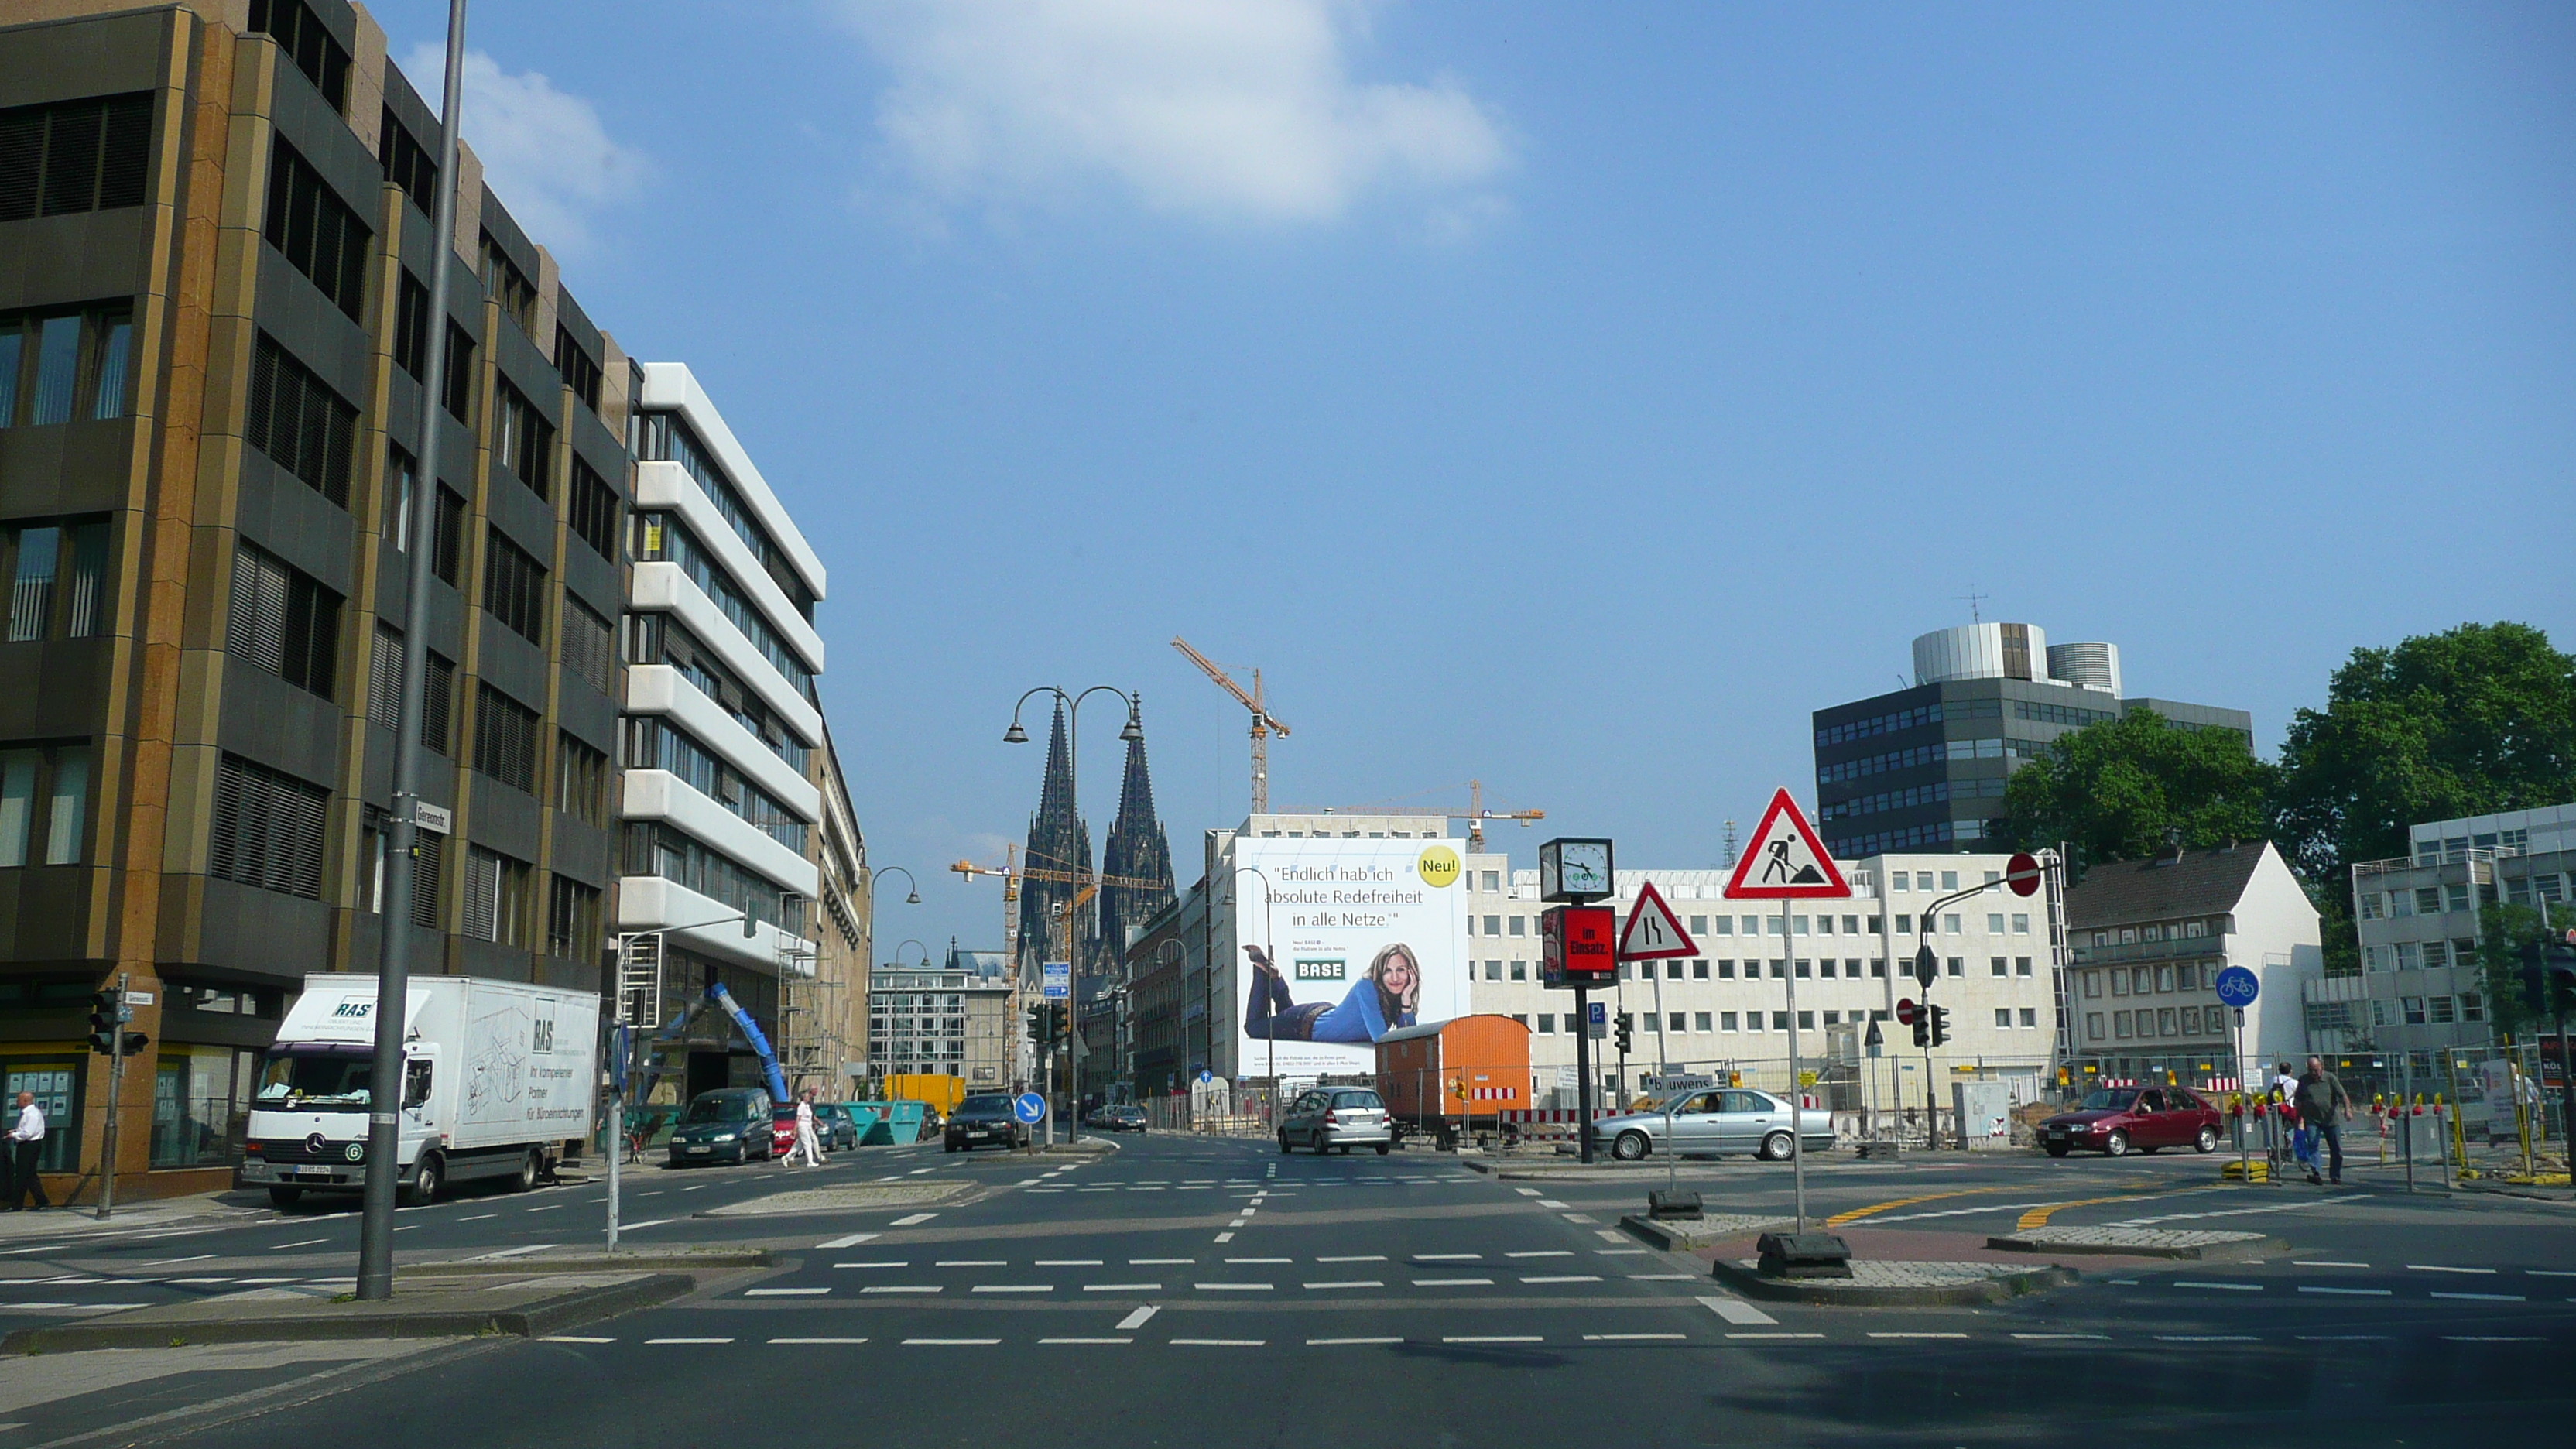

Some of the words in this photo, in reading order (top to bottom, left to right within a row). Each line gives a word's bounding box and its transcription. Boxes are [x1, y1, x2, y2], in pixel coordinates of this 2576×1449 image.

[418, 807, 446, 827] Gereonstr.
[1423, 859, 1456, 872] Neu!
[1340, 867, 1368, 881] hab
[1372, 867, 1394, 881] ich
[1264, 889, 1328, 903] absolute
[1333, 889, 1423, 903] Redefreiheit
[1292, 913, 1306, 927] in
[1311, 912, 1337, 927] alle
[1570, 940, 1608, 954] Einsatz.
[1299, 963, 1342, 977] BASE
[335, 1003, 372, 1016] RAS
[1591, 1005, 1601, 1020] P
[533, 1019, 553, 1051] RAS
[2543, 1061, 2562, 1070] KÖL
[1654, 1078, 1709, 1091] buwens
[350, 1147, 358, 1157] G
